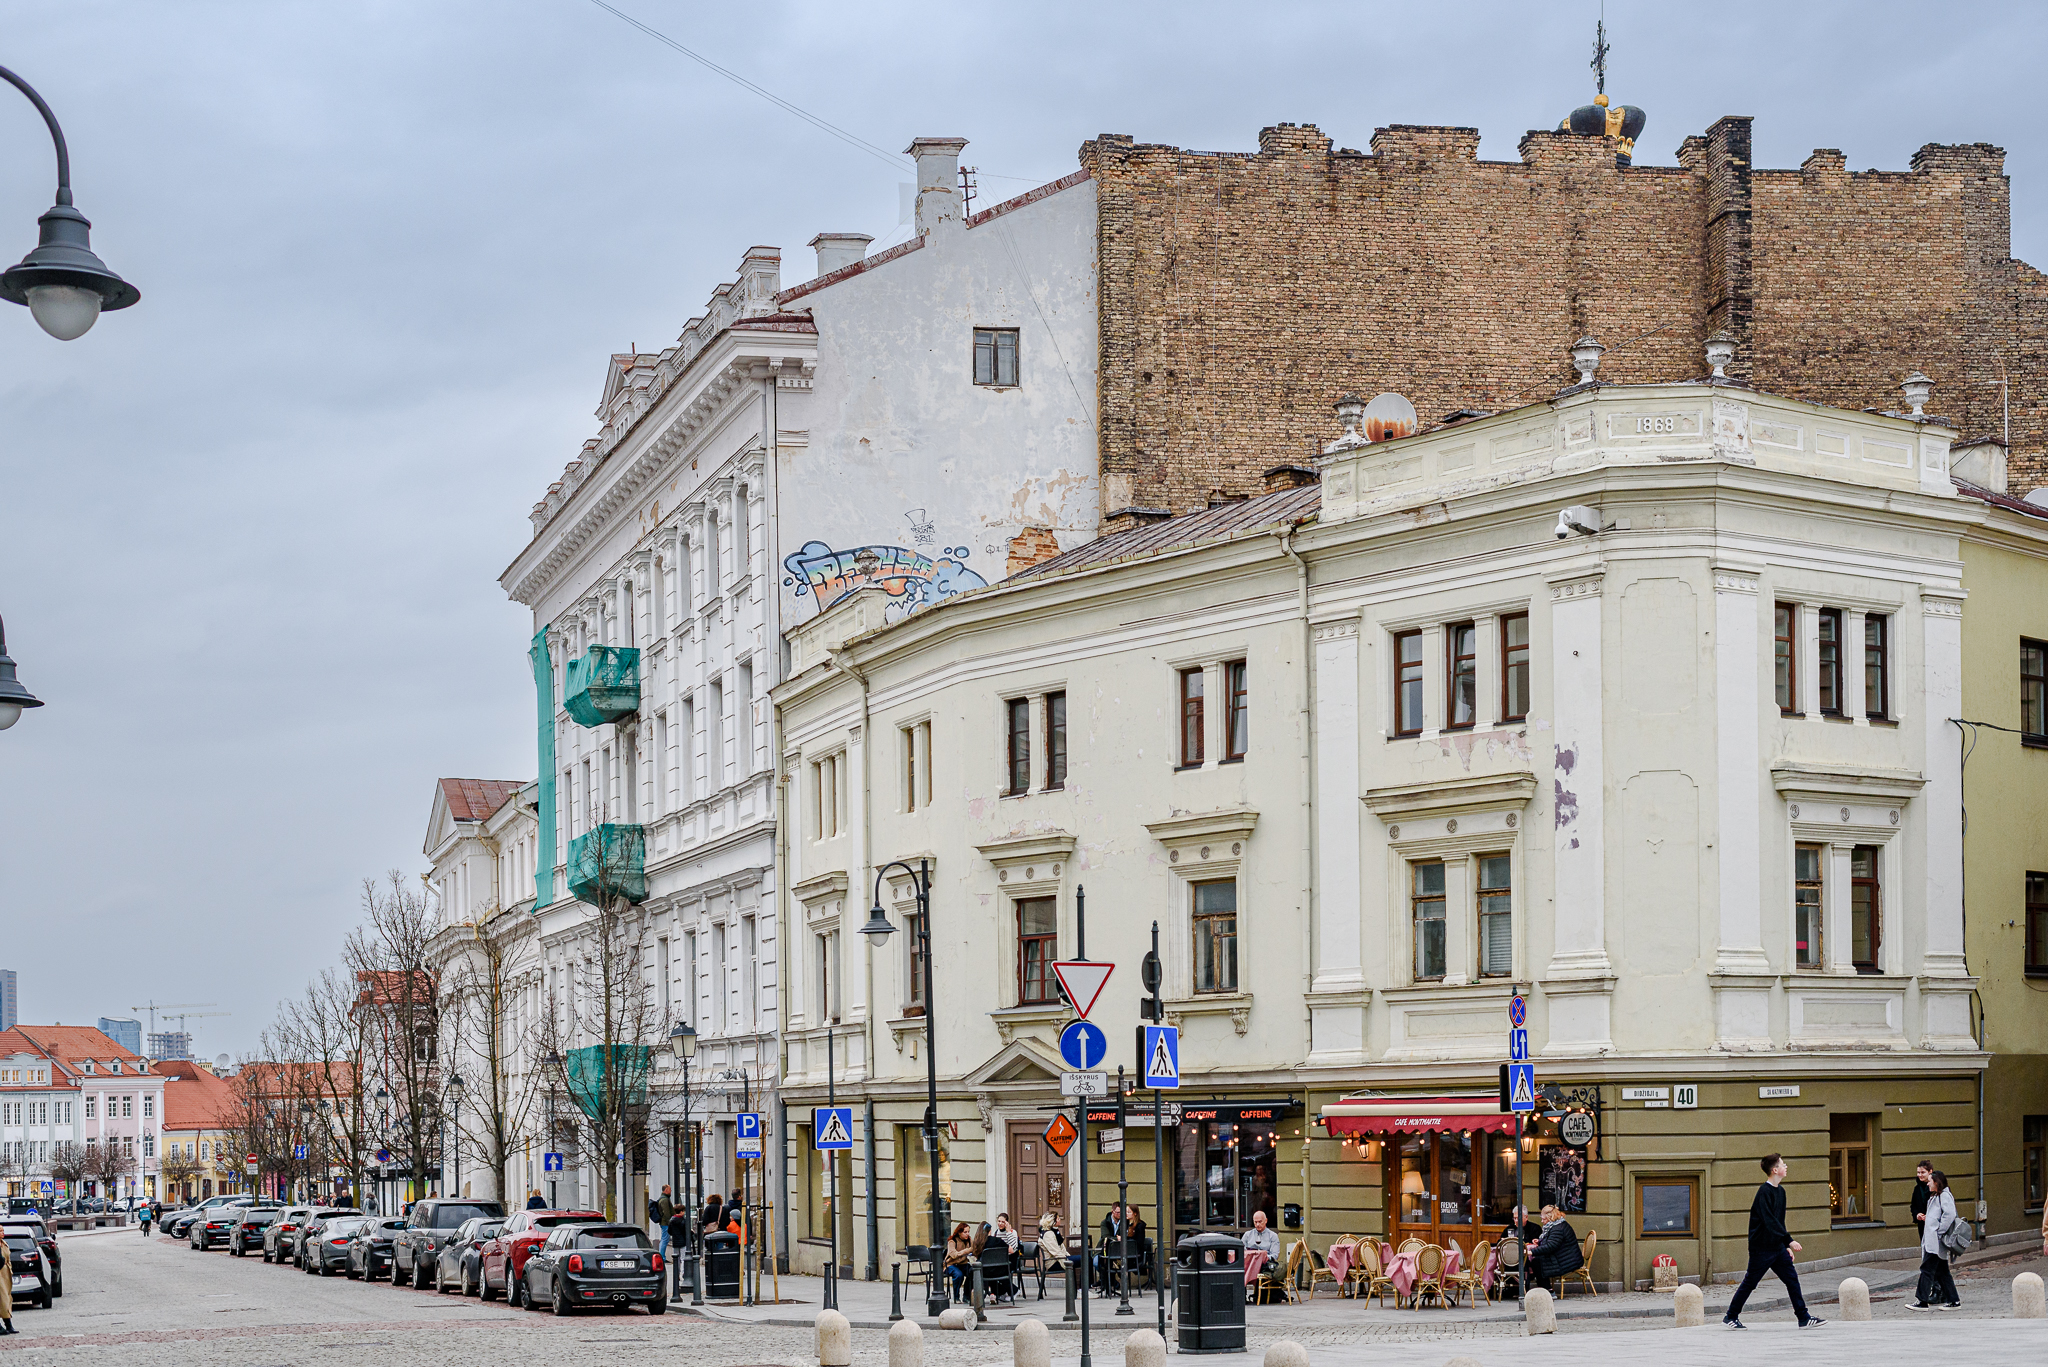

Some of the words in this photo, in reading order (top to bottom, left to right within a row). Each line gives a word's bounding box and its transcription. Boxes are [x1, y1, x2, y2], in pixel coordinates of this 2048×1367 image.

[1636, 417, 1674, 433] 1868
[1677, 1088, 1694, 1105] 40
[1087, 1112, 1116, 1120] CAFFEINE
[1185, 1110, 1217, 1119] CAFFEINE
[1240, 1110, 1272, 1119] CAFFEINE
[743, 1115, 756, 1136] P
[1394, 1118, 1408, 1126] CAFÉ
[1568, 1115, 1586, 1130] CAFÉ
[1658, 1255, 1672, 1267] N7
